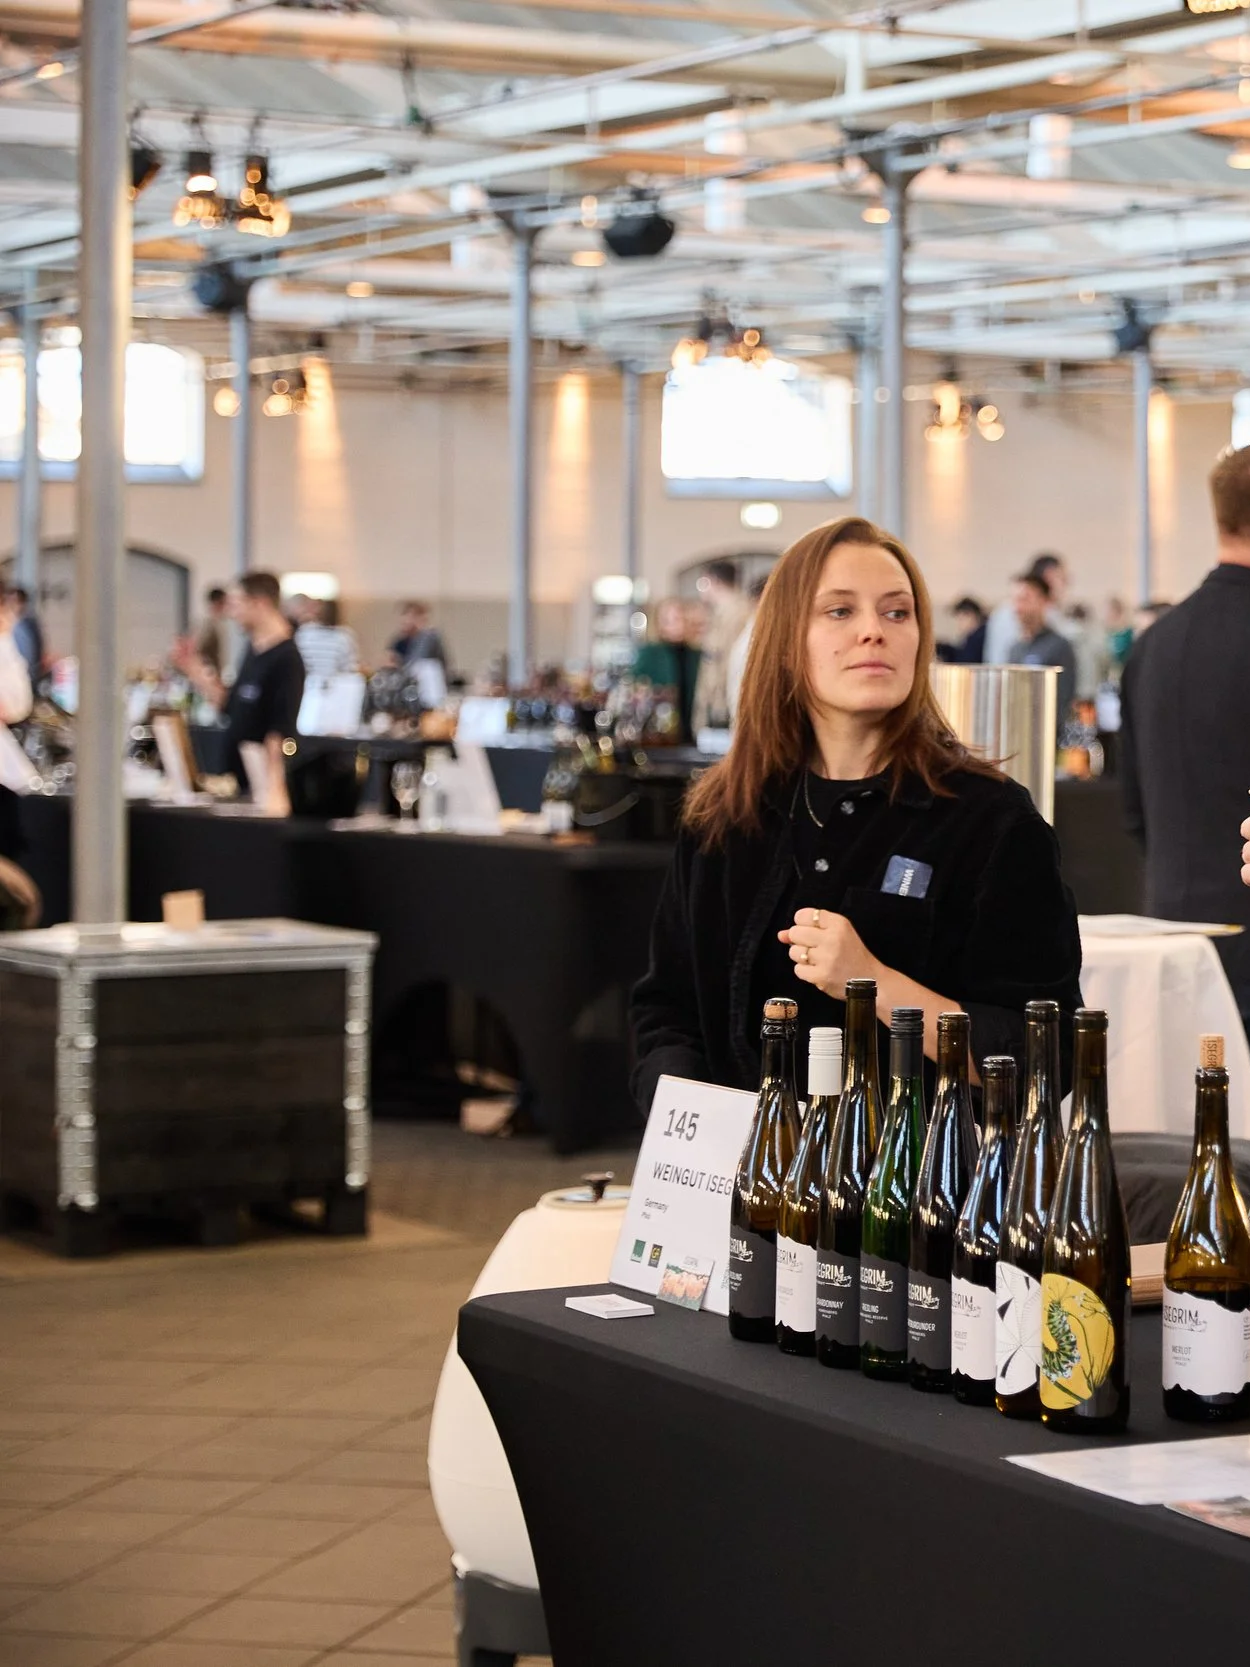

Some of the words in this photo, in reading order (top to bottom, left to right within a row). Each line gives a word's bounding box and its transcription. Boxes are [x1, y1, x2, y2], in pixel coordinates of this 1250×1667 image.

[664, 1108, 699, 1141] 145
[653, 1161, 706, 1189] WEINGUT
[706, 1174, 733, 1196] ISEG
[1172, 1345, 1191, 1355] MERLOT
